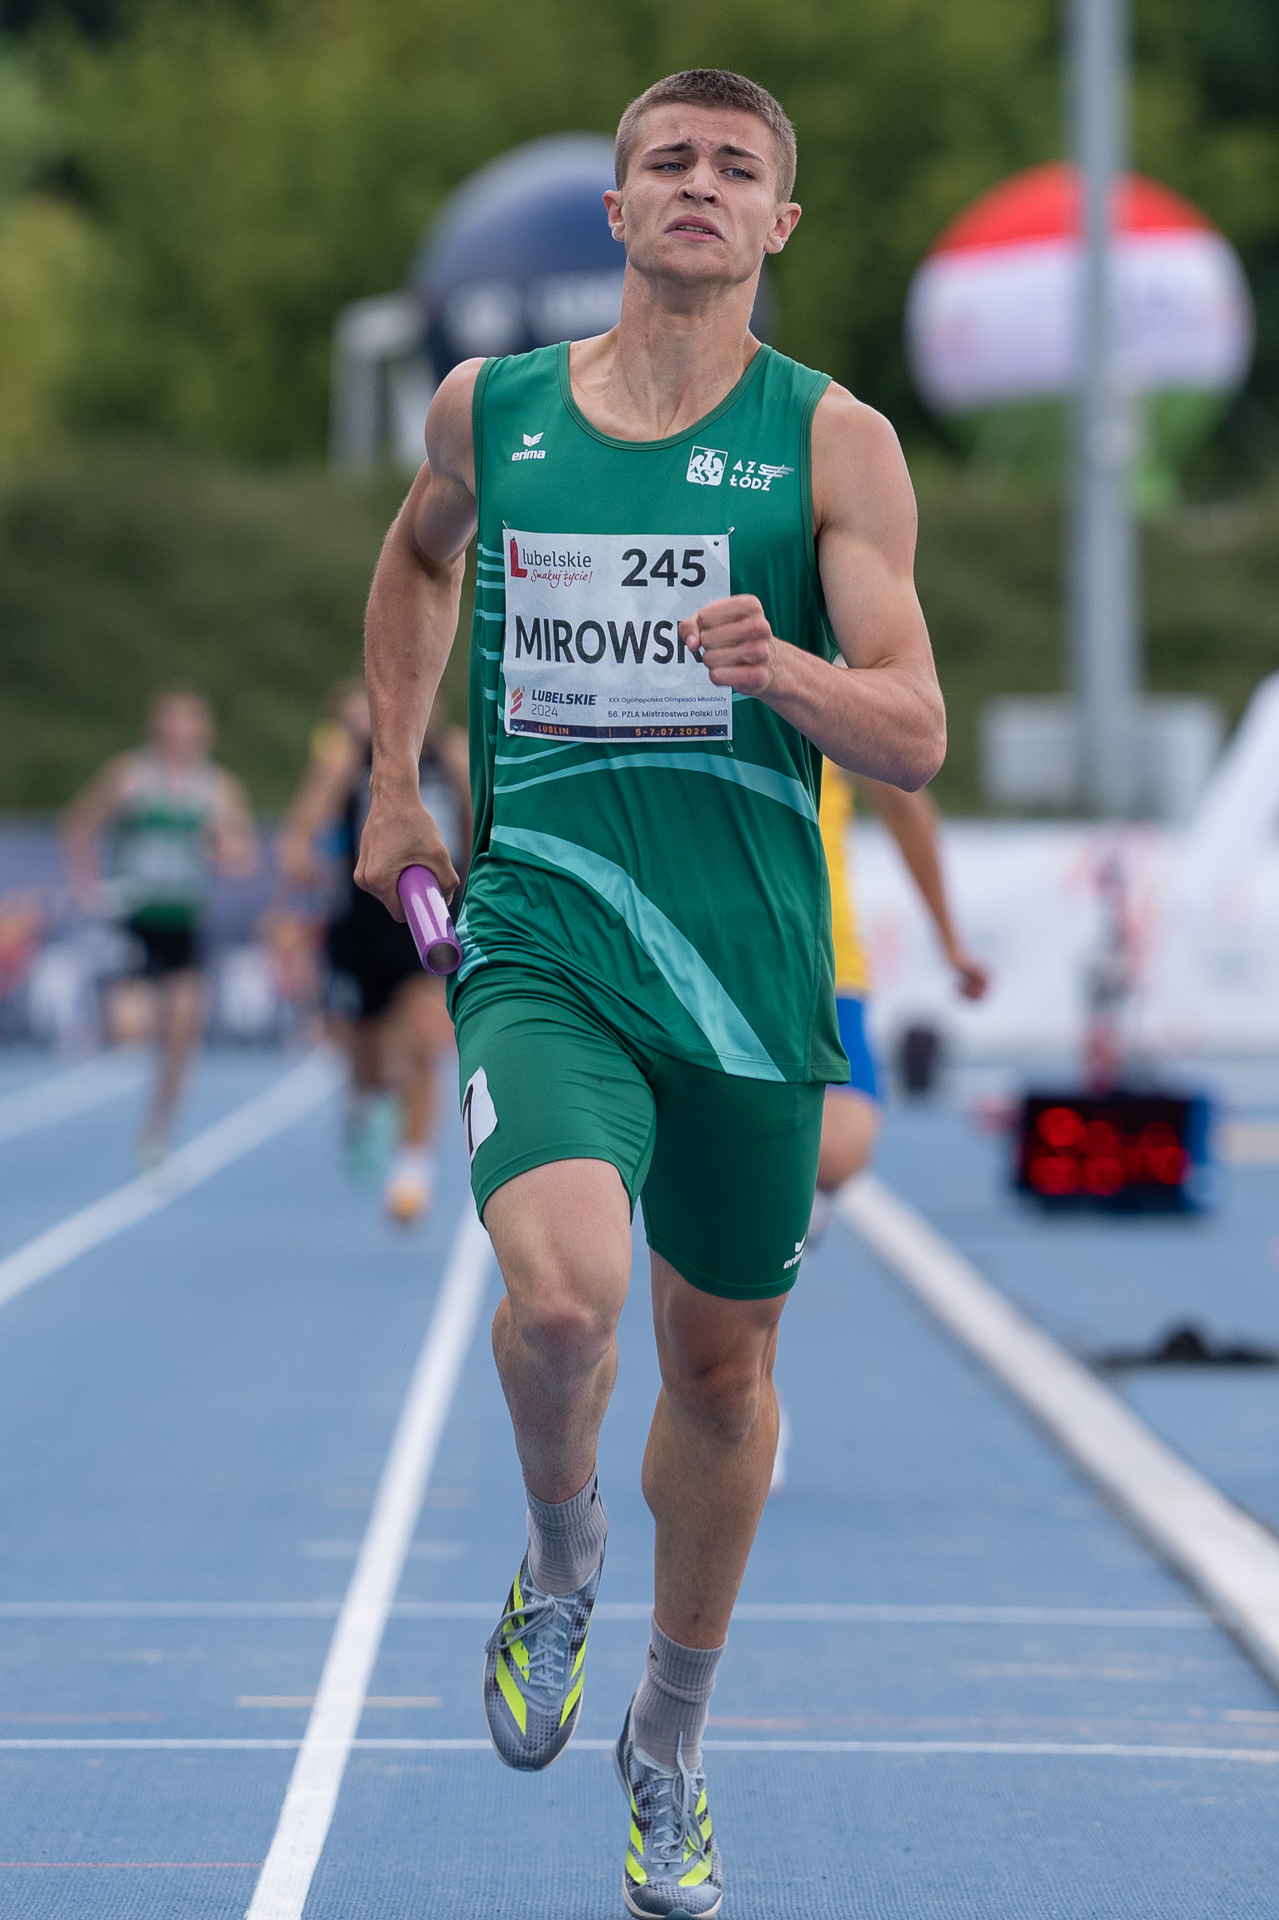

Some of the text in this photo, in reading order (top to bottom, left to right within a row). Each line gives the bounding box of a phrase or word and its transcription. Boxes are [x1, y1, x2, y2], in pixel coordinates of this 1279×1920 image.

[511, 449, 546, 461] erima
[733, 459, 795, 478] AZS
[621, 548, 706, 587] 245
[531, 569, 593, 589] Smakuj życie!
[531, 689, 598, 706] LUBELSKIE
[621, 696, 664, 704] Ogólnopolska
[664, 696, 697, 704] Olimpiada
[531, 703, 559, 718] 2024
[607, 709, 728, 718] 56. PZLA Mistrzostwa Polski U18
[538, 724, 569, 735] LUBLIN
[635, 727, 707, 736] 5-7.07.2024
